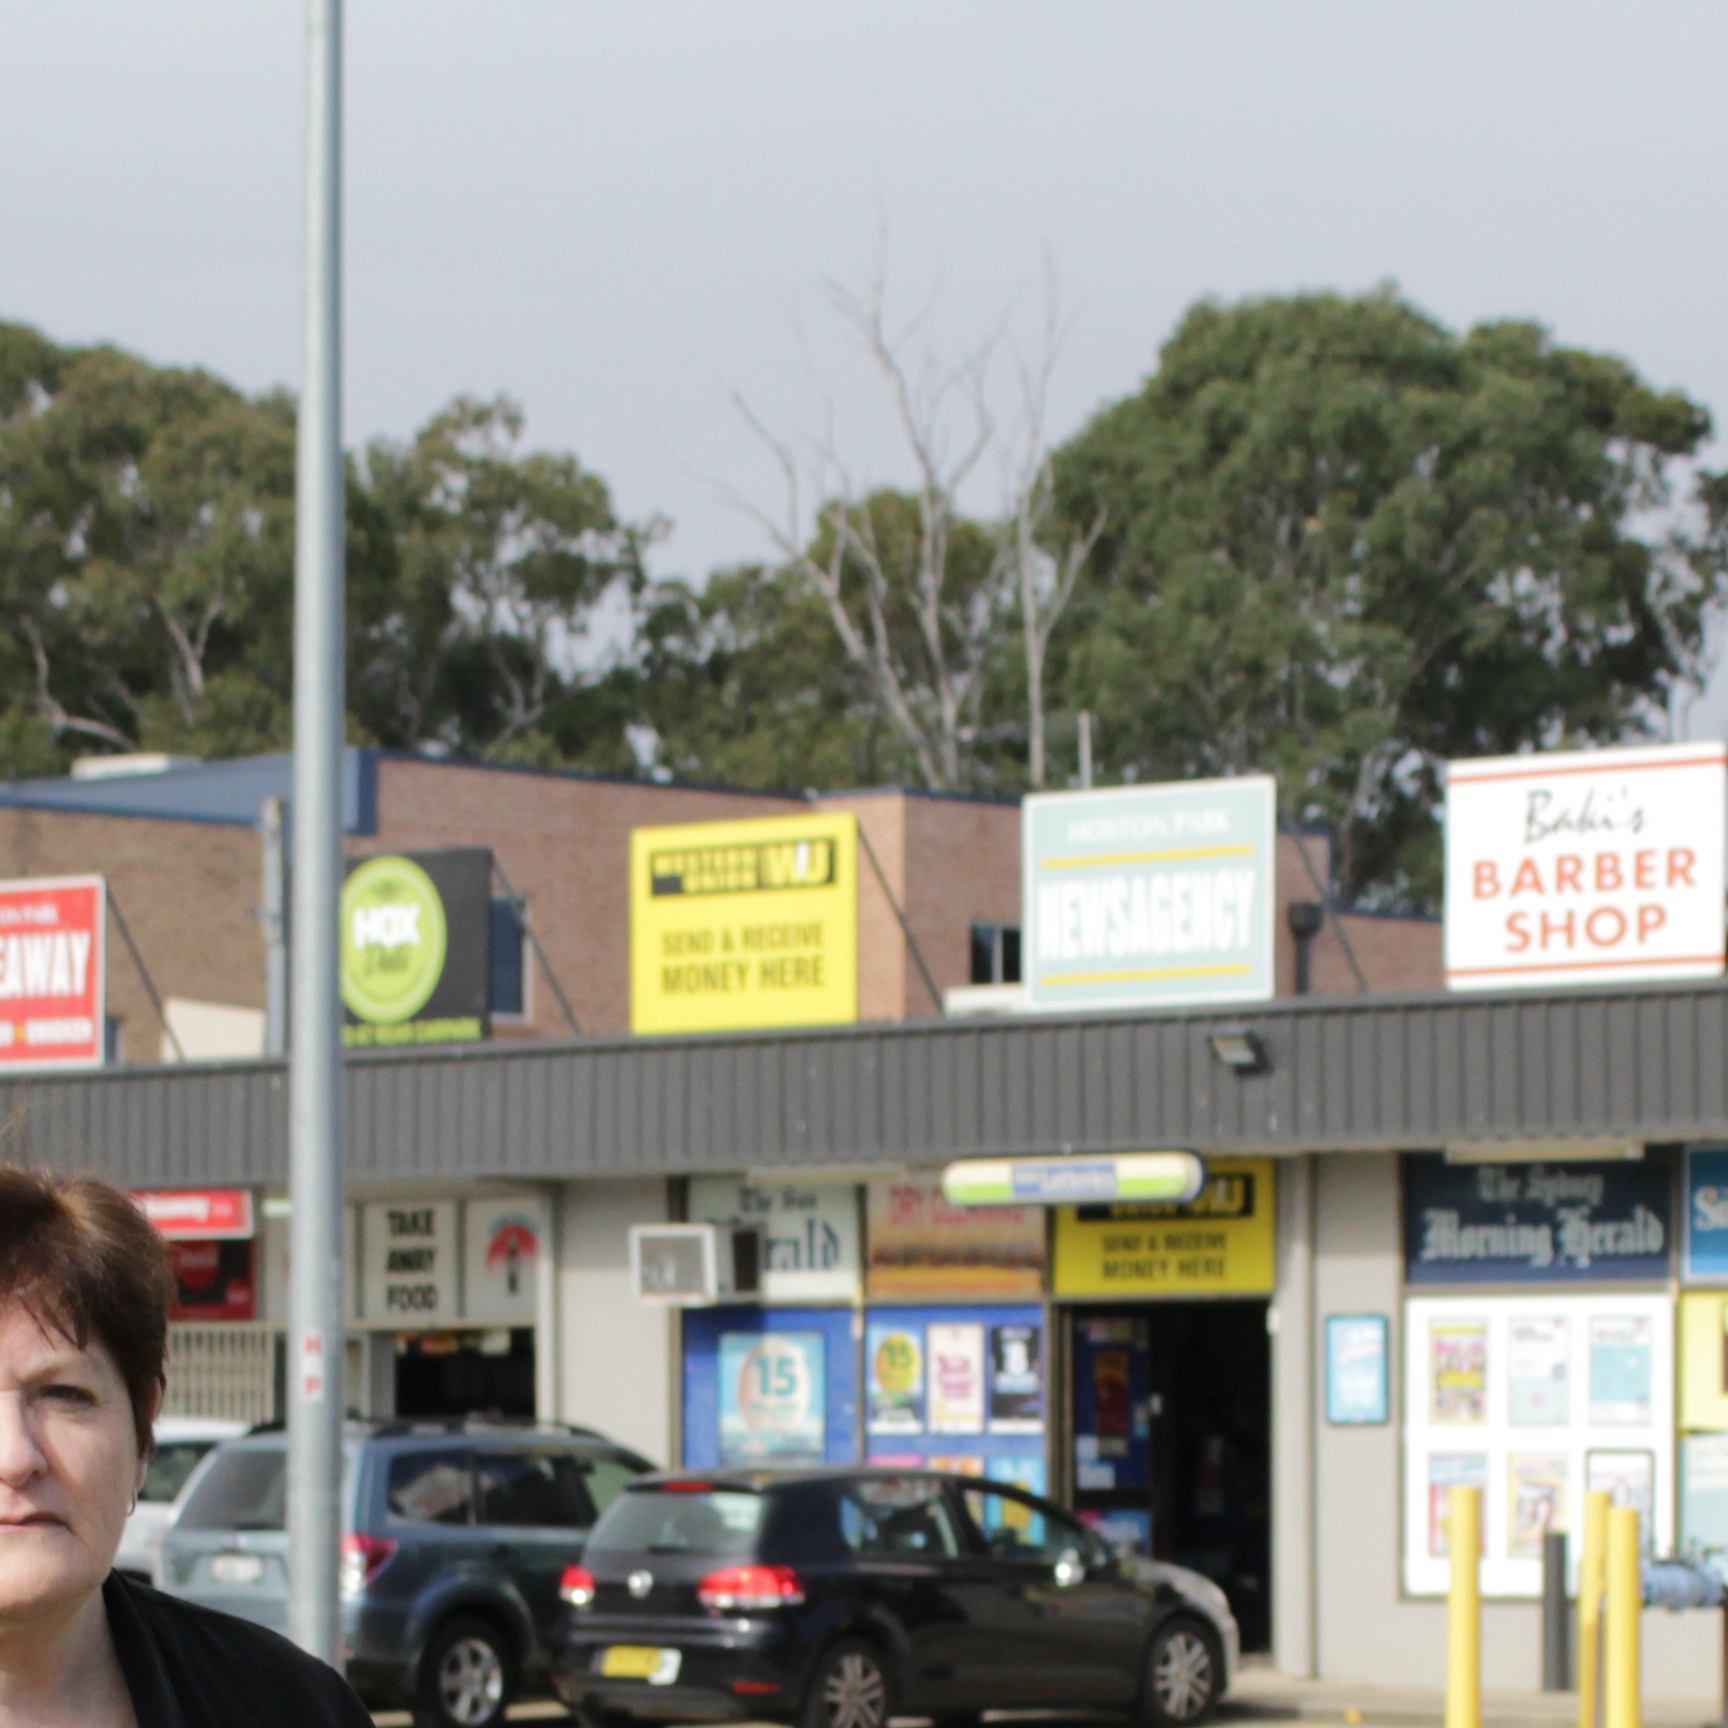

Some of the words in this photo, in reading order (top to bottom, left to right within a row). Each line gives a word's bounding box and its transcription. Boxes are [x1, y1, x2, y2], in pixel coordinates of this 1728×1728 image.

[1068, 813, 1168, 842] HOXTON
[1173, 808, 1230, 834] PARK
[1473, 847, 1697, 901] BARBER
[353, 903, 421, 948] HOX
[1038, 867, 1256, 960] NEWSAGENCY
[1504, 903, 1668, 953] SHOP
[663, 929, 713, 957] SEND
[742, 921, 823, 950] RECEIVE
[663, 961, 750, 995] MONEY
[758, 954, 825, 989] HERE
[388, 1210, 435, 1237] TAKE
[1423, 1207, 1554, 1268] Morning
[1556, 1204, 1665, 1268] Herald
[387, 1248, 435, 1273] AWAY
[1102, 1260, 1168, 1280] MONEY
[1177, 1258, 1226, 1278] HERE
[387, 1285, 439, 1311] FOOD
[757, 1355, 798, 1397] 15
